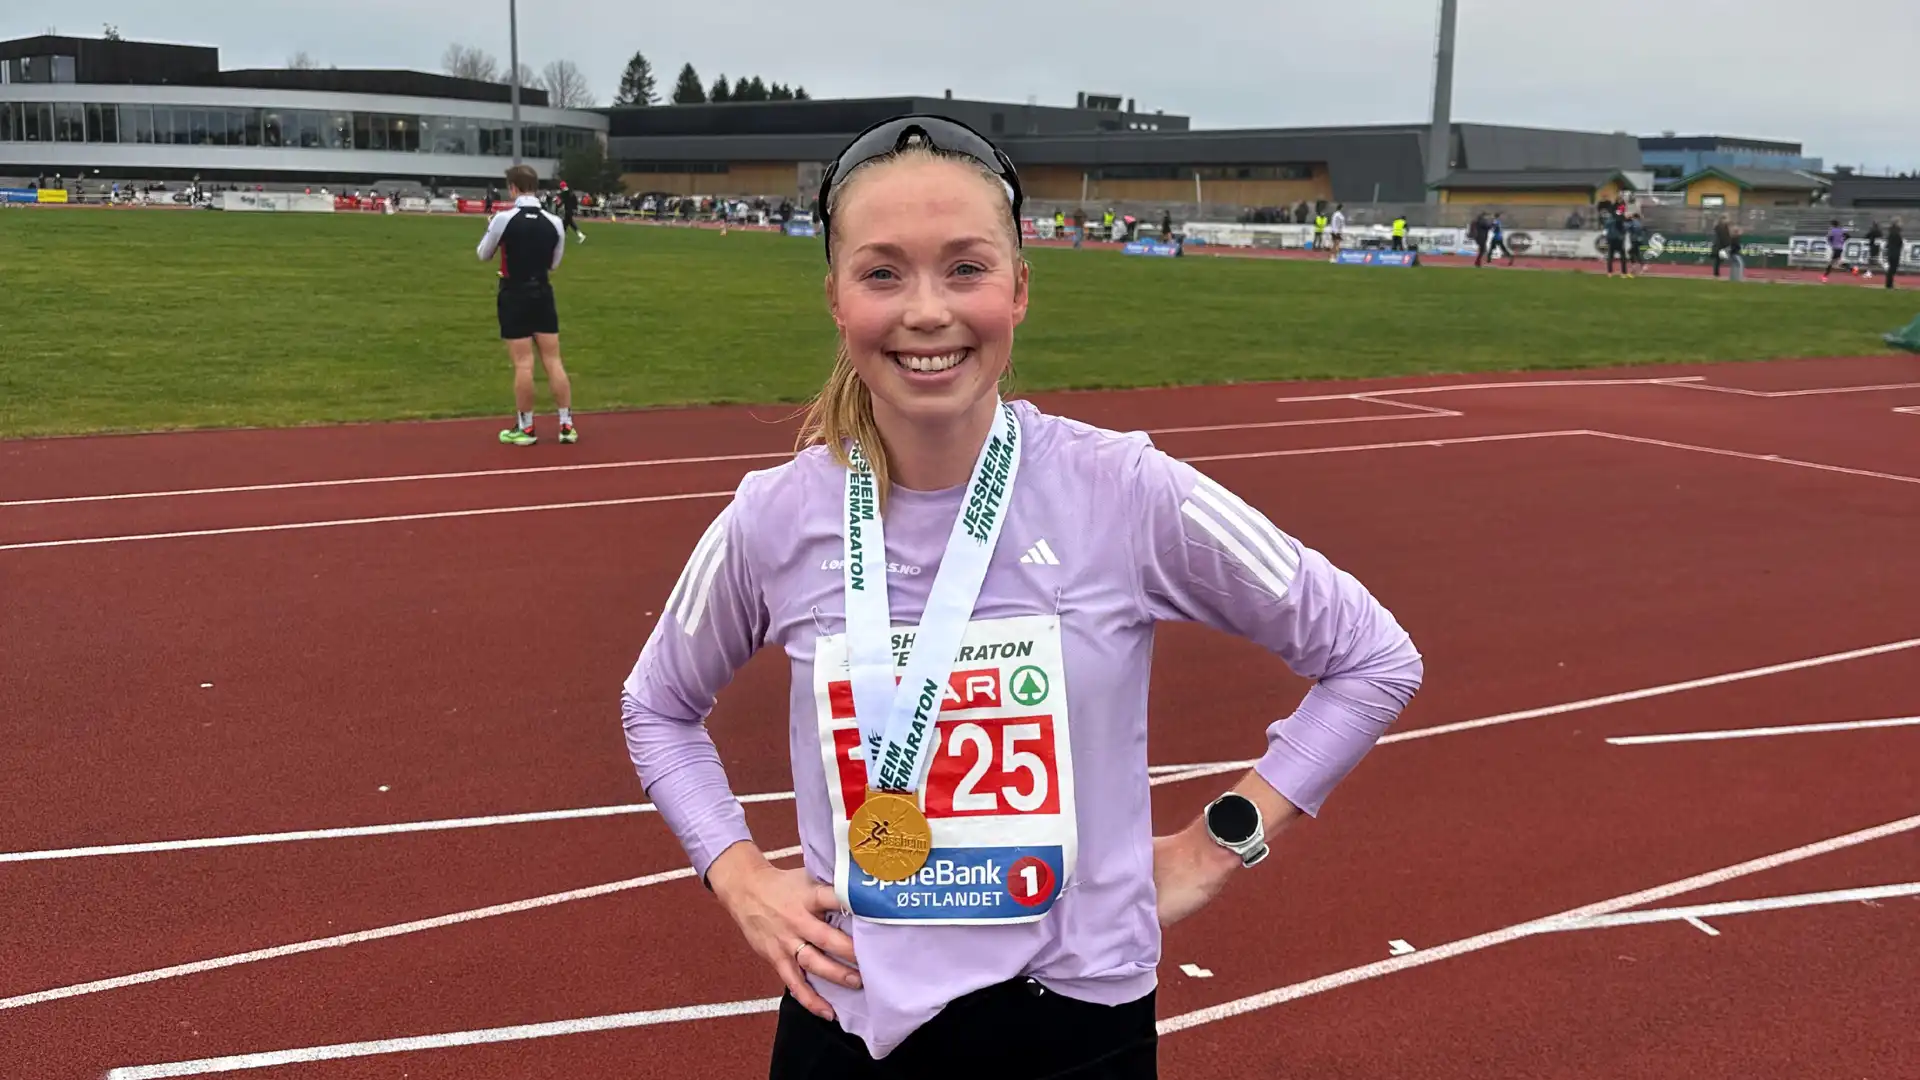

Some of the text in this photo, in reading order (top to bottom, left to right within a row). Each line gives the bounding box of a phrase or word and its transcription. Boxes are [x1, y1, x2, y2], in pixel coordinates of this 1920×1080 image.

[963, 435, 1001, 535] JESSHEIM
[974, 404, 1017, 546] VINTERMARAT
[896, 891, 1003, 907] ØSTLANDET
[1020, 865, 1039, 897] 1
